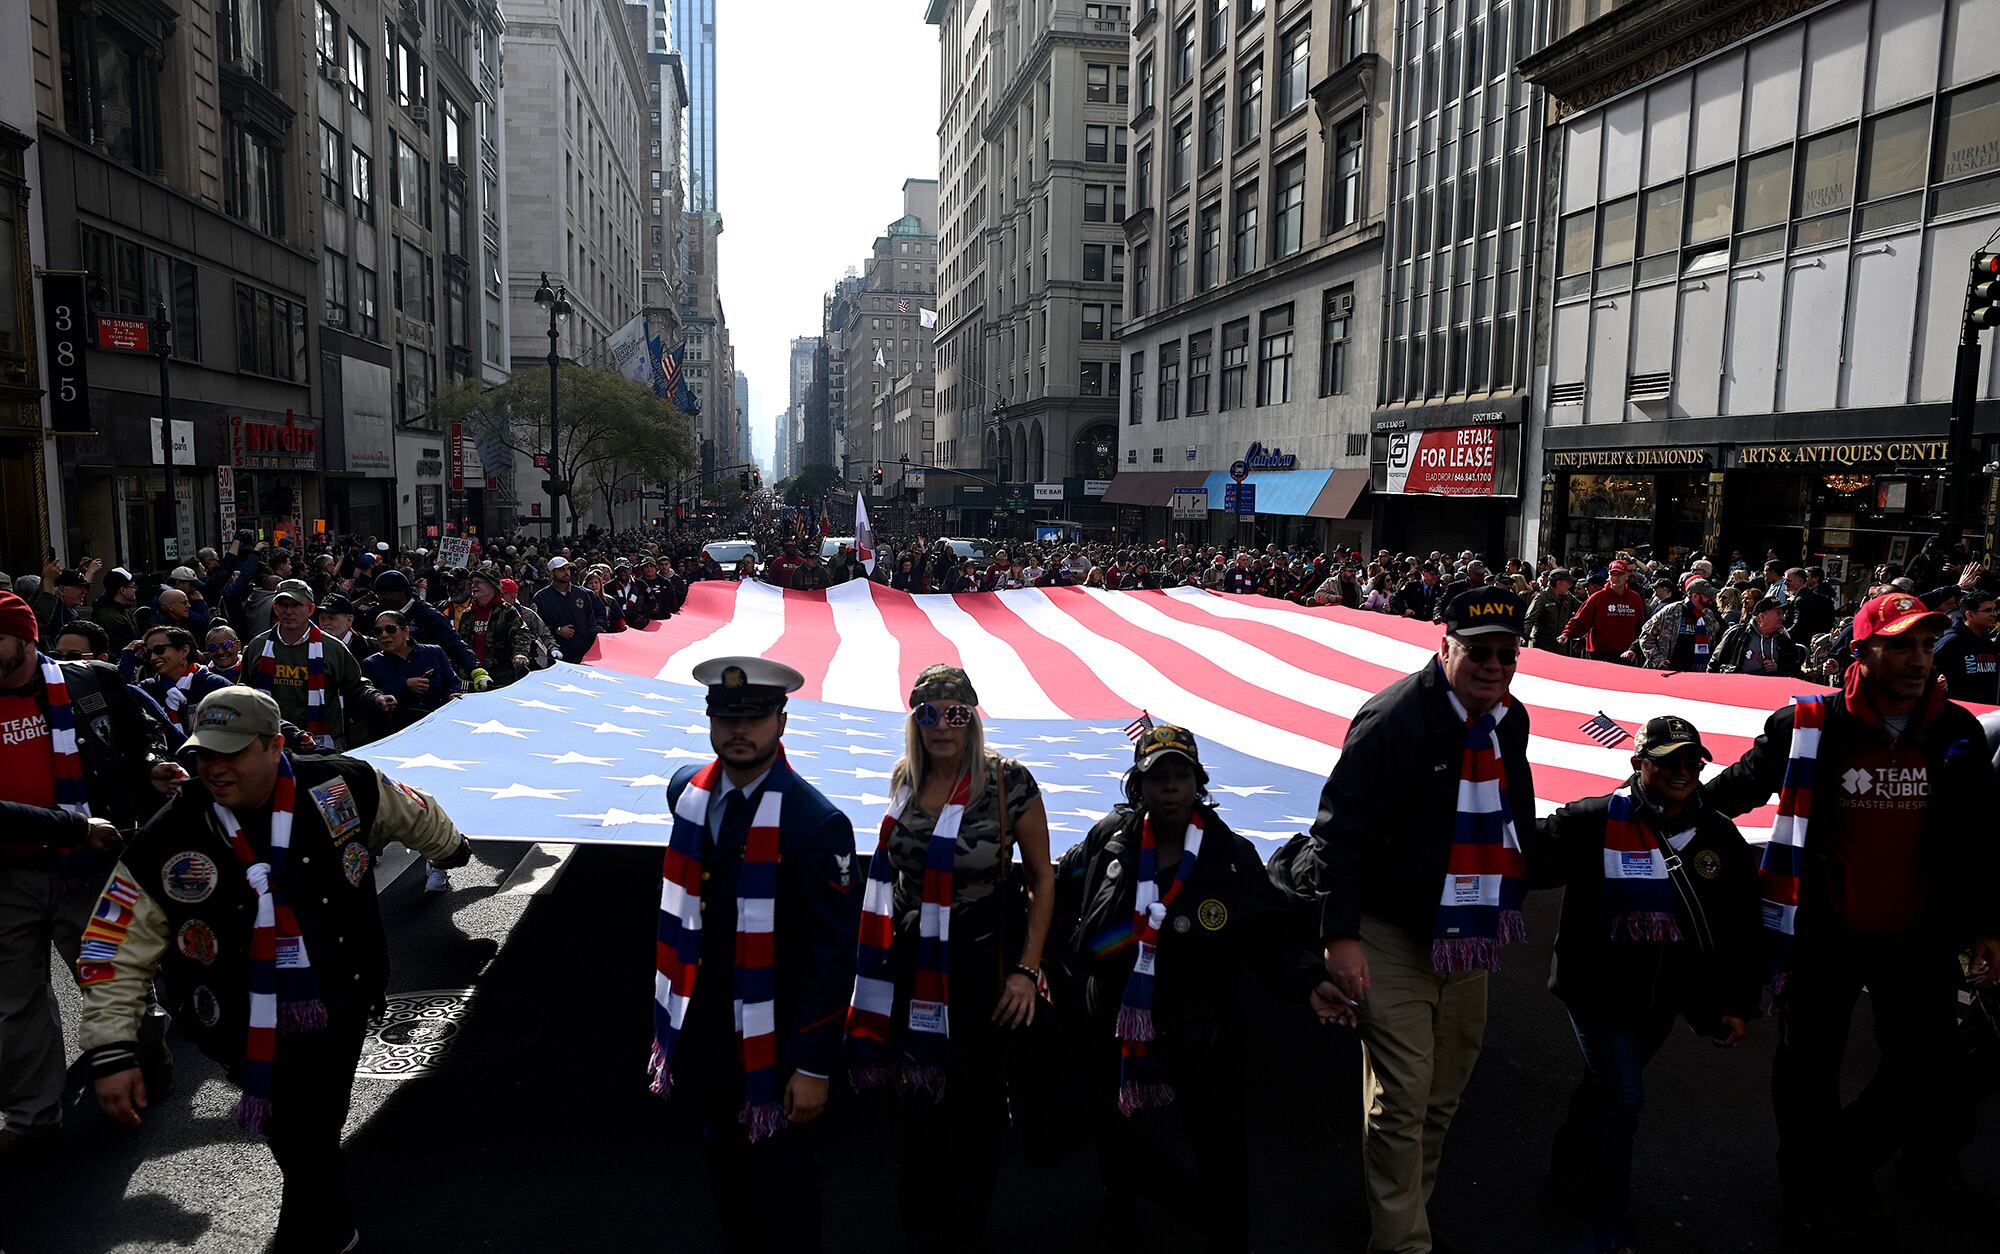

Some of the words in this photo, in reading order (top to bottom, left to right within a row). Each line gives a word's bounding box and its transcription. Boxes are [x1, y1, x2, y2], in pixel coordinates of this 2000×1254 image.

[1951, 141, 2000, 163] MIRIAM
[1807, 183, 1843, 200] MIRIAM
[101, 319, 111, 327] NO
[113, 320, 144, 329] STANDING
[1472, 411, 1504, 422] FOOTWEAR
[453, 435, 461, 457] MILL
[1345, 433, 1368, 457] JUDY
[1457, 428, 1493, 446] RETAIL
[1244, 440, 1297, 468] Rainbow
[1420, 448, 1447, 468] FOR
[1449, 446, 1493, 468] LEASE
[1553, 451, 1579, 466] FINE
[1576, 450, 1624, 468] JEWELRY
[1625, 450, 1635, 465] &
[1637, 449, 1704, 465] DIAMONDS
[1738, 446, 1777, 464] ARTS
[1778, 447, 1793, 463] &
[1794, 443, 1884, 466] ANTIQUES
[453, 460, 461, 478] THE
[1425, 473, 1437, 482] ELAD
[1468, 602, 1514, 618] NAVY
[274, 664, 309, 680] RMY
[1965, 654, 1977, 675] NYC
[273, 678, 305, 687] RETIRED
[0, 713, 47, 732] TEAM
[1875, 767, 1928, 782] TEAM
[1838, 798, 1895, 809] DISASTER
